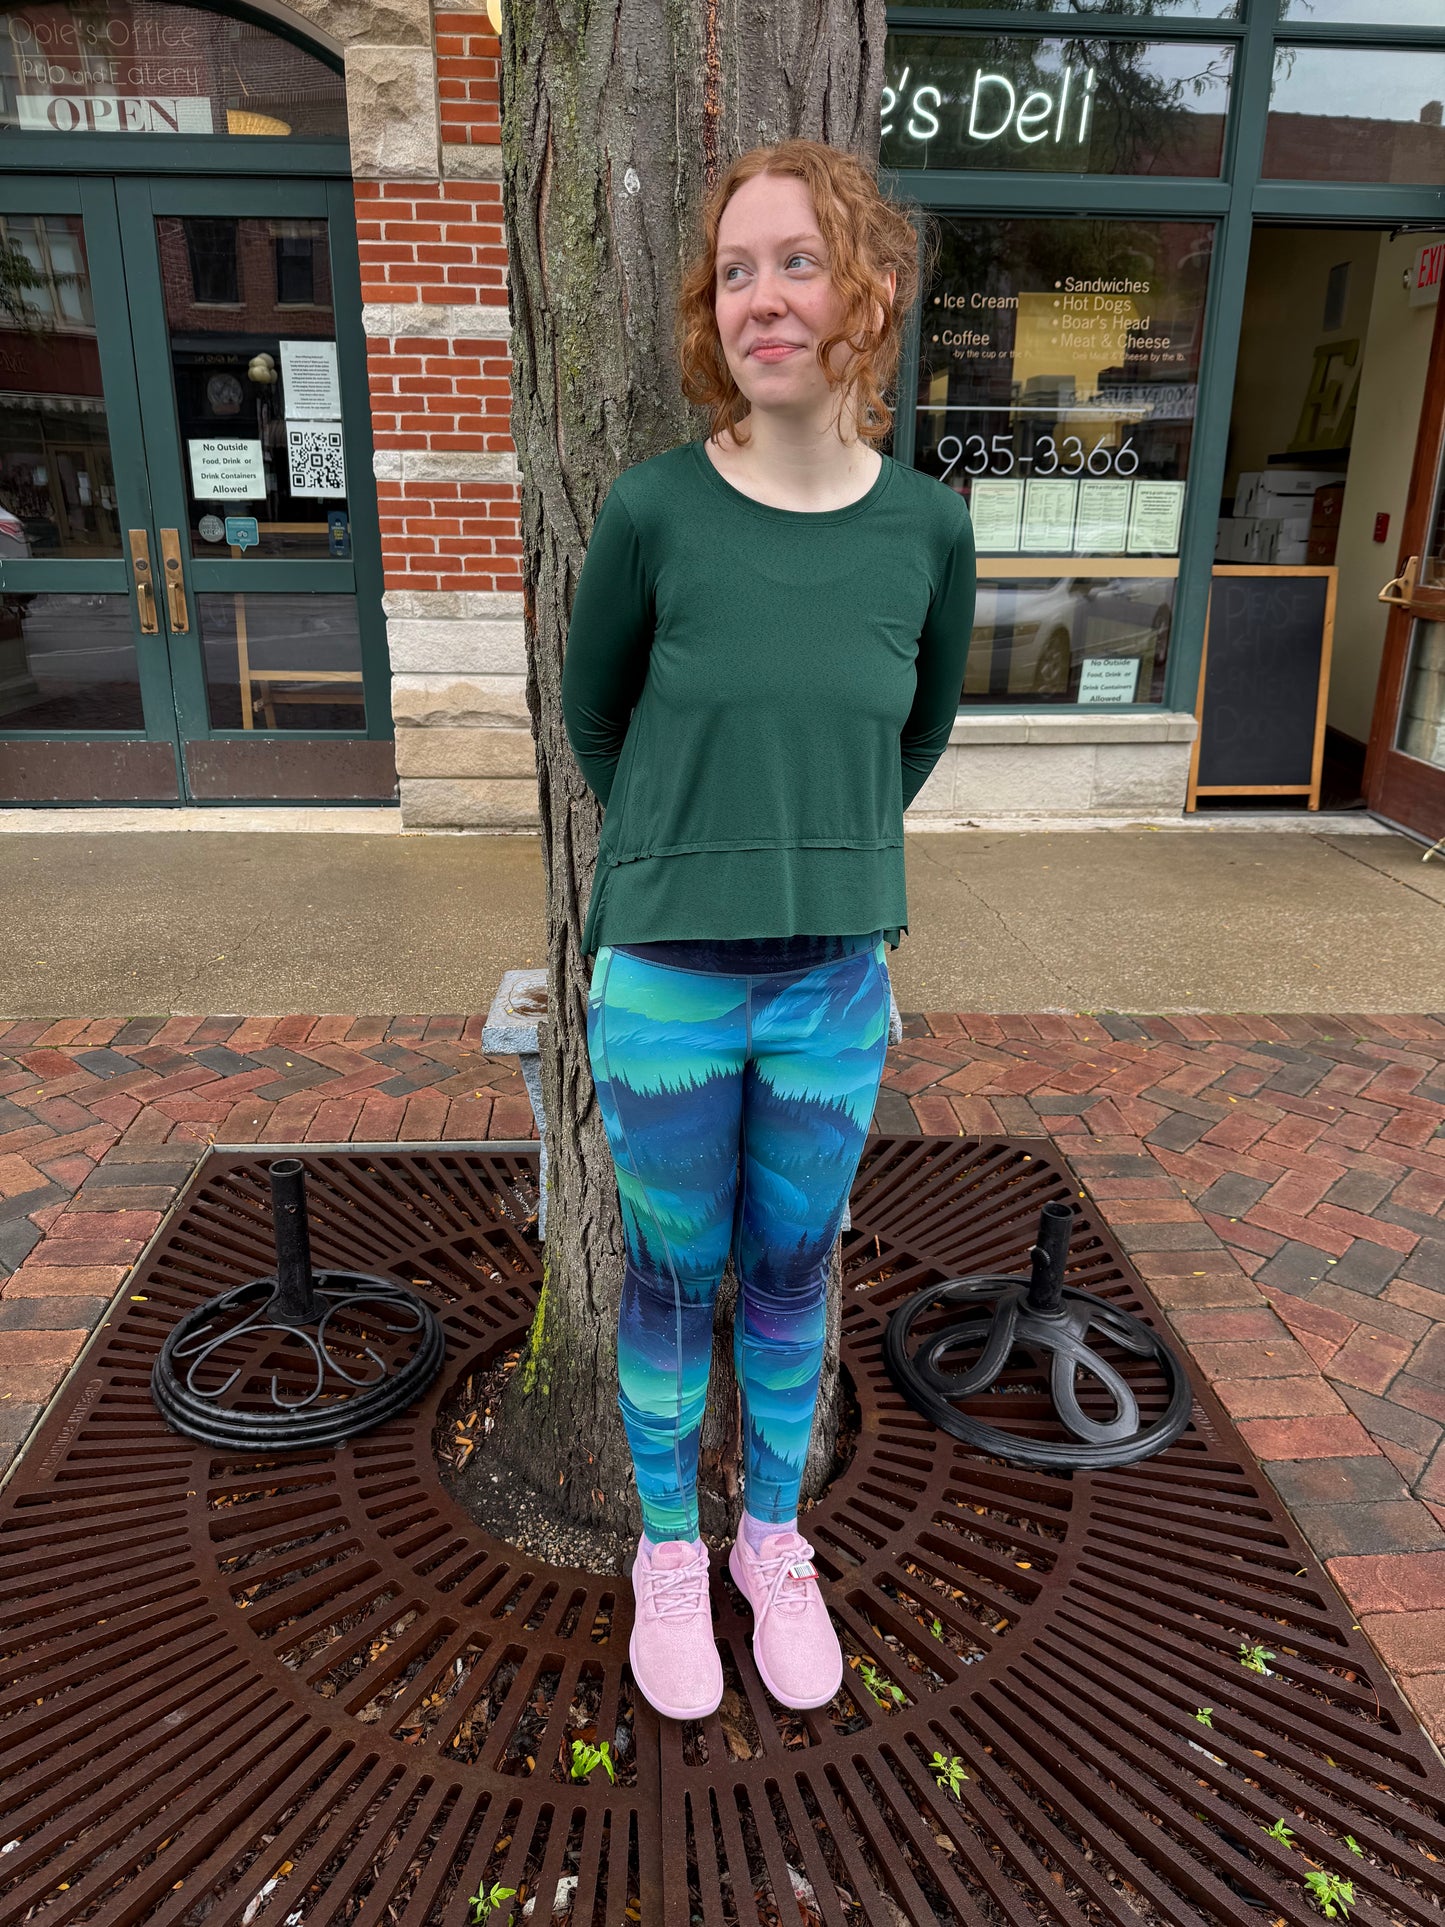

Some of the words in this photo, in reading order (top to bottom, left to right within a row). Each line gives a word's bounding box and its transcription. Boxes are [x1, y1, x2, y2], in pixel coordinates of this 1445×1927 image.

[8, 17, 97, 53] Opie's
[106, 18, 197, 51] Office
[21, 59, 65, 85] Pub
[72, 67, 104, 85] and
[110, 61, 200, 95] Eatery
[968, 66, 1095, 144] Deli
[46, 97, 180, 132] OPEN
[1417, 244, 1445, 288] EXI
[1064, 276, 1151, 294] Sandwiches
[943, 293, 966, 309] Ice
[970, 293, 1019, 309] Cream
[1062, 295, 1089, 312] Hot
[1093, 296, 1132, 315] Dogs
[1061, 314, 1108, 331] Boar's
[1112, 315, 1151, 331] Head
[941, 330, 990, 347] Coffee
[1060, 333, 1097, 349] Meat
[1100, 334, 1113, 349] &
[1116, 334, 1171, 350] Cheese
[966, 349, 980, 359] the
[981, 350, 997, 360] cup
[998, 350, 1008, 359] or
[1150, 352, 1161, 364] by
[1162, 352, 1175, 362] the
[203, 443, 215, 451] No
[217, 443, 248, 451] Outside
[937, 434, 1140, 482] 935-3366
[212, 485, 248, 493] Allowed
